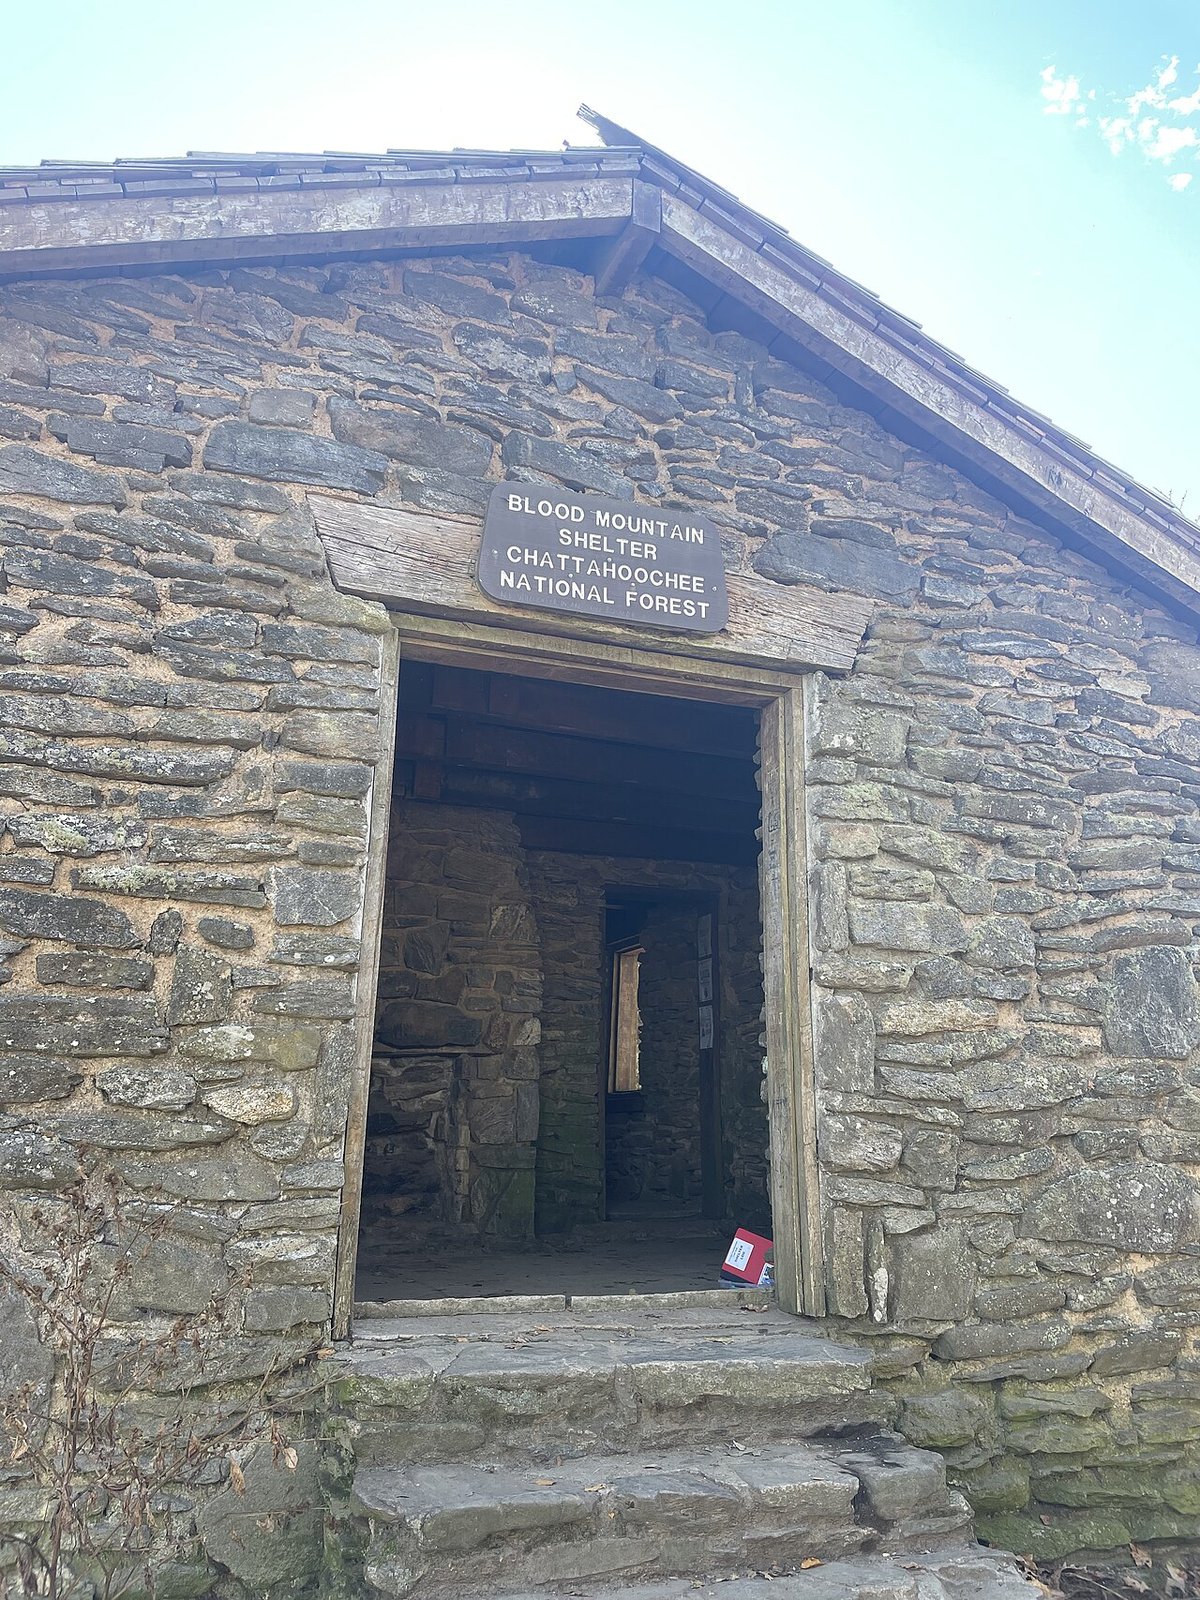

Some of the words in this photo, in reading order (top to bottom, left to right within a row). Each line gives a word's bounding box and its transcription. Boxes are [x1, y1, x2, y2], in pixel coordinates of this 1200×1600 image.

[506, 493, 585, 523] BLOOD
[595, 510, 704, 545] MOUNTAIN
[558, 528, 657, 561] SHELTER
[500, 569, 615, 605] NATIONAL
[625, 590, 710, 619] FOREST
[506, 545, 705, 594] CHATTAHOOCHEE
